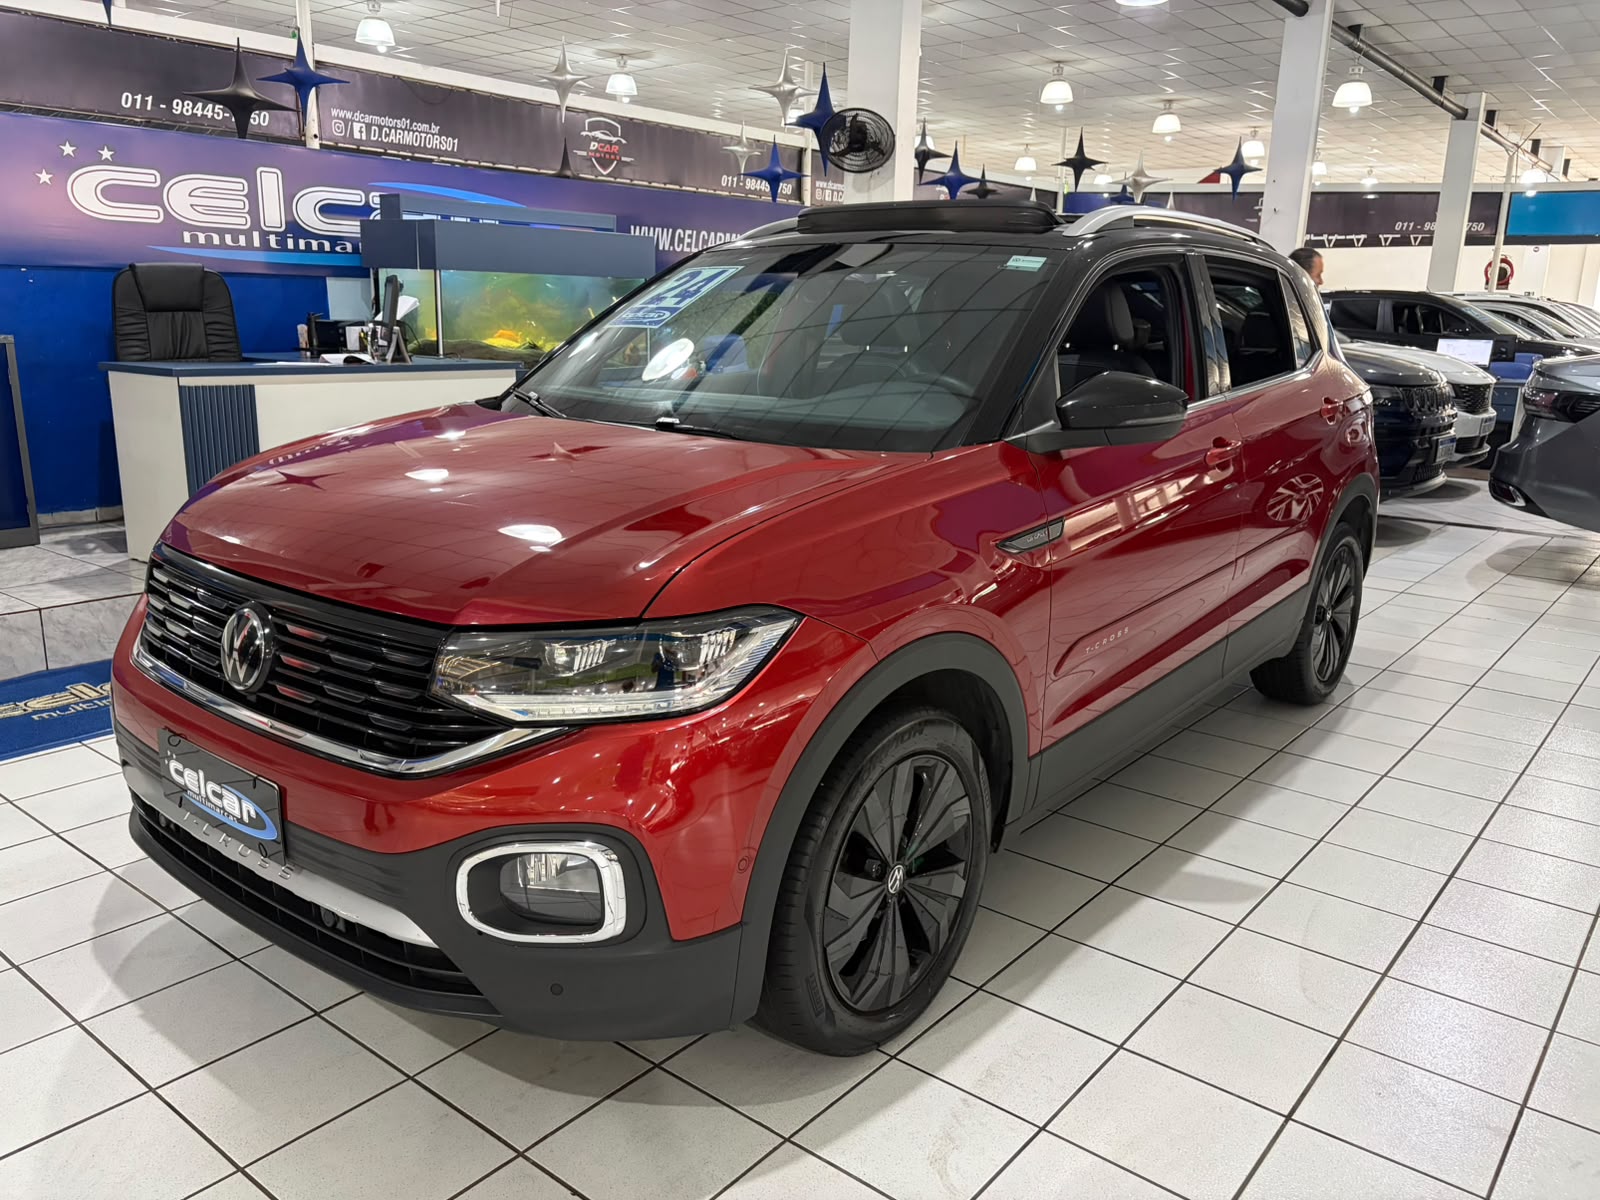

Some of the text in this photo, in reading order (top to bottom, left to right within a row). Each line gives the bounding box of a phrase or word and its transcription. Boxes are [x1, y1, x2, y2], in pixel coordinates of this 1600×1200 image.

[121, 92, 153, 111] 011
[172, 99, 269, 126] 98445-50
[331, 107, 440, 134] www.dcarmotors01.com.br
[370, 125, 459, 152] D.CARMOTORS01
[589, 141, 619, 154] DCAR
[721, 174, 737, 188] 011
[745, 178, 792, 195] 98445750
[66, 164, 390, 238] celc
[1395, 221, 1414, 231] 011
[183, 230, 362, 254] multima
[1085, 626, 1129, 654] T-CROSS
[169, 759, 257, 823] celcar
[187, 789, 238, 824] multimarcas
